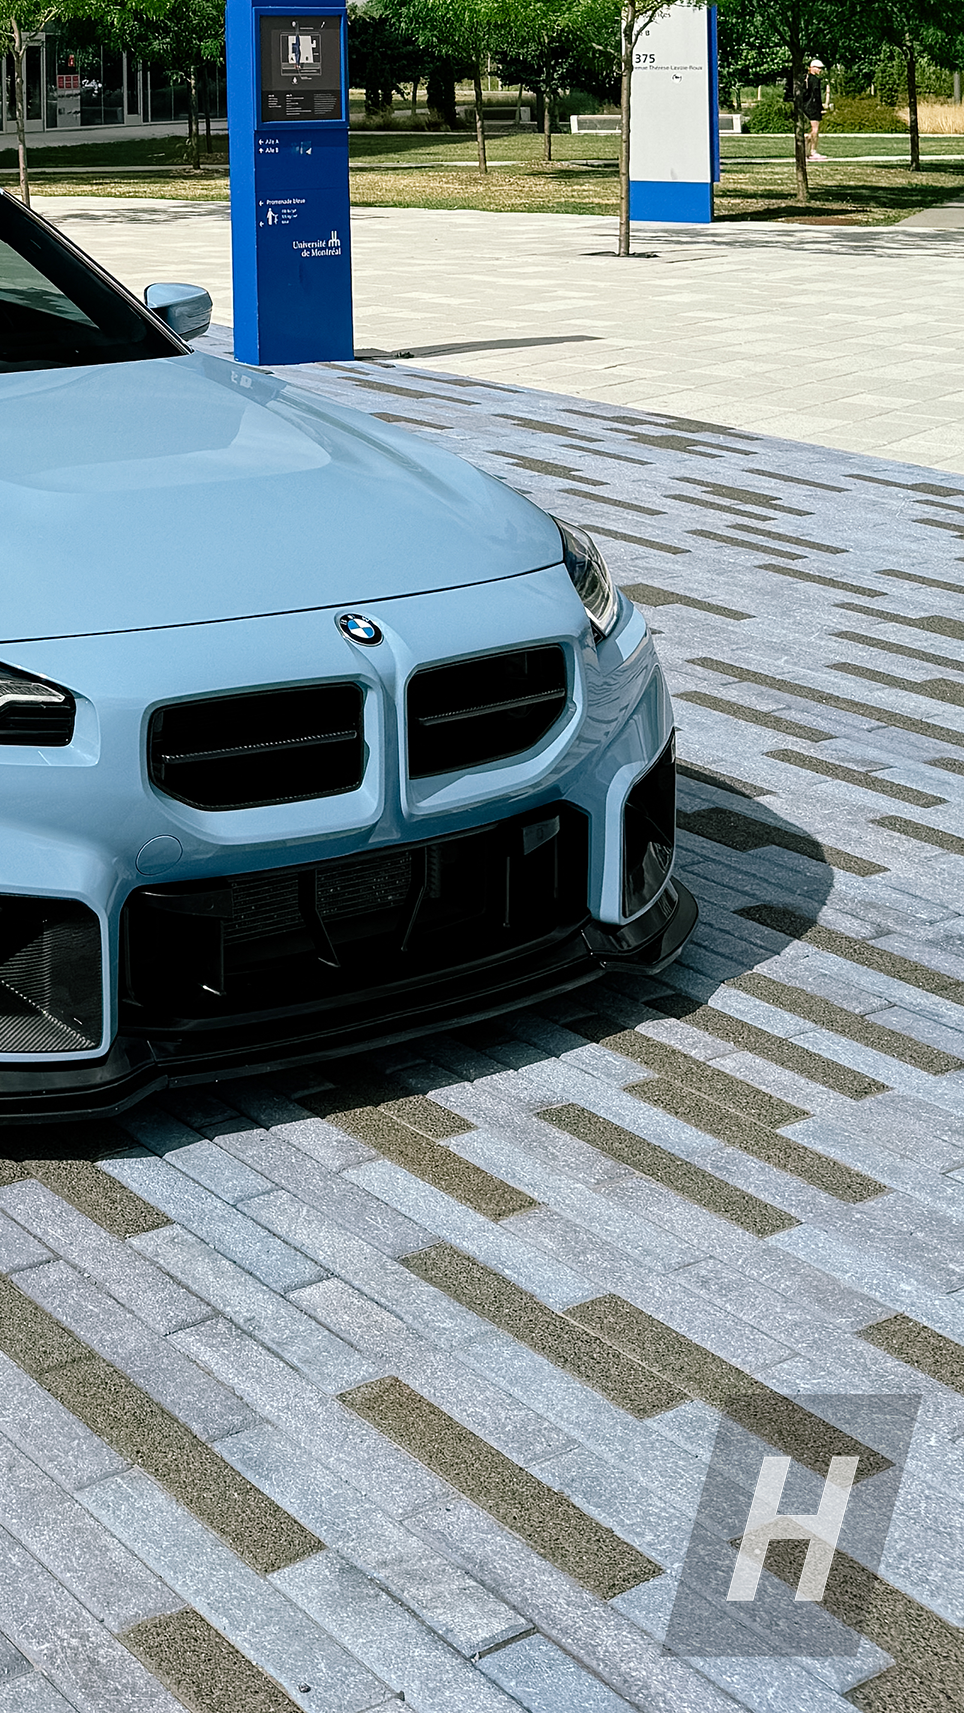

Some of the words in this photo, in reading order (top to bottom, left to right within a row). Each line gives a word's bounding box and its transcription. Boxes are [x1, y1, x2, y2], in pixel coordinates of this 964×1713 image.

[292, 240, 326, 249] Université
[301, 249, 310, 257] de
[311, 247, 341, 257] Montréal
